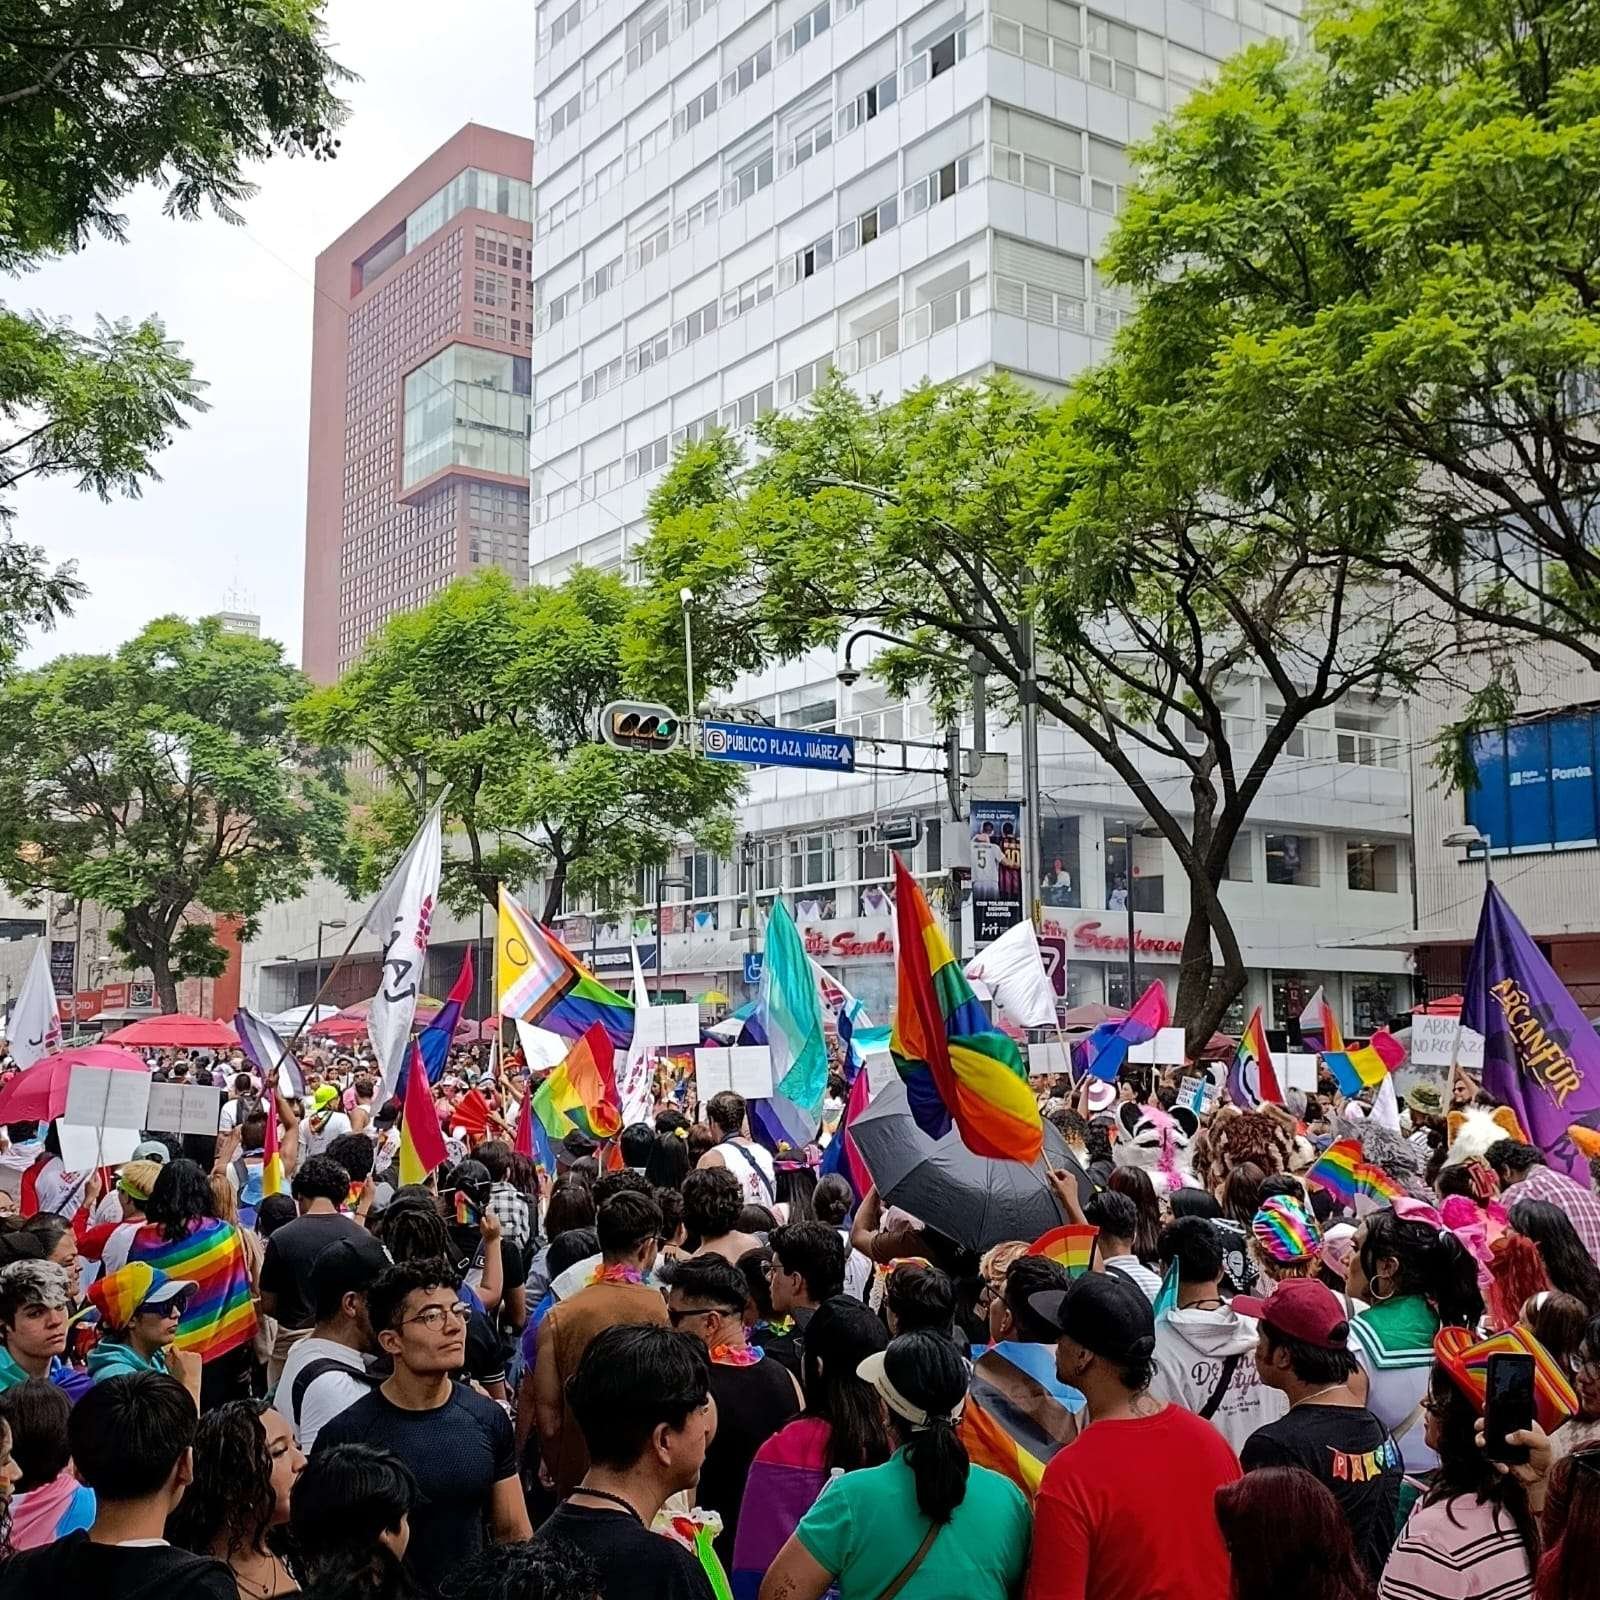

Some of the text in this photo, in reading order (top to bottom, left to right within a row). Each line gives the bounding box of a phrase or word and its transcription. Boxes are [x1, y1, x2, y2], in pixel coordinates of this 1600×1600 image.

[727, 730, 767, 753] PÚBLICO
[770, 739, 801, 757] PLAZA
[804, 738, 839, 760] JUÁREZ
[977, 850, 987, 869] 5
[1004, 849, 1020, 868] 10
[1413, 1040, 1429, 1053] NO
